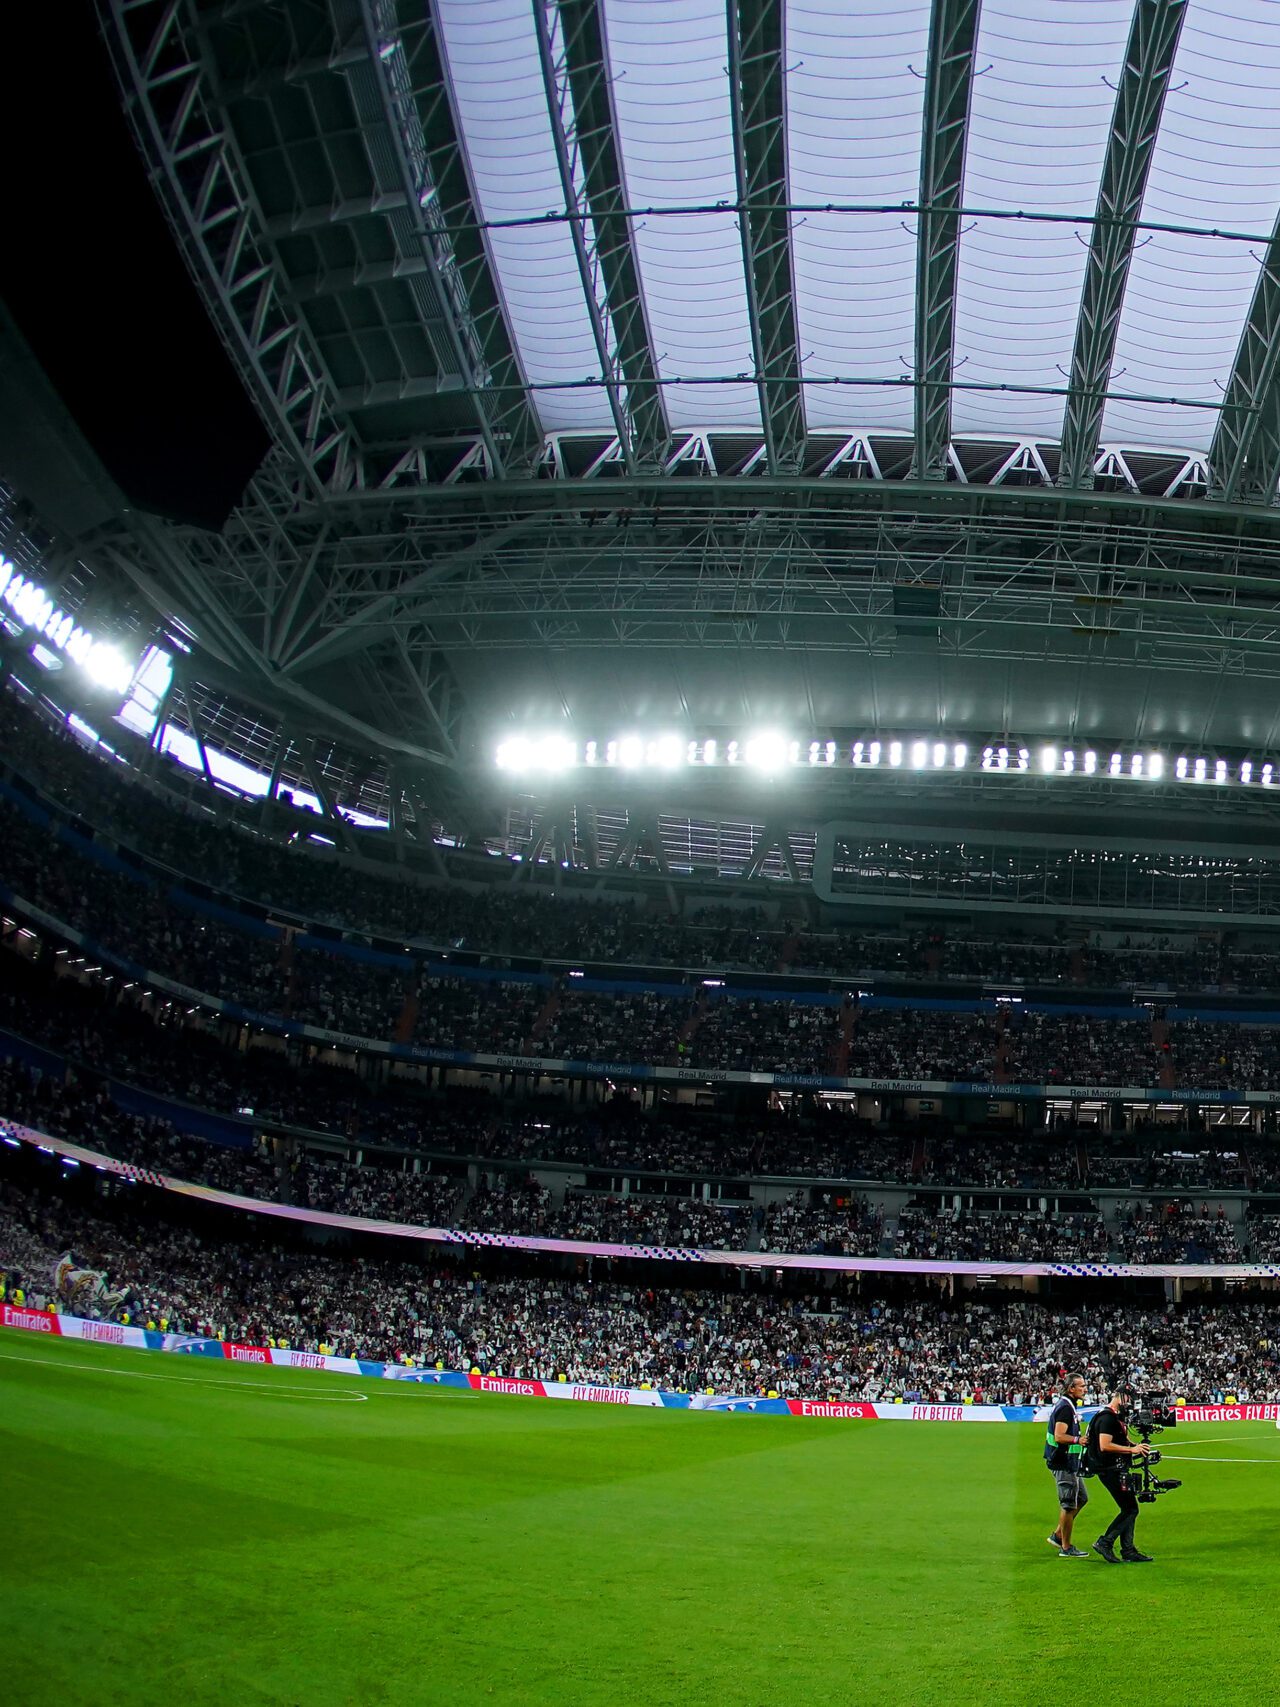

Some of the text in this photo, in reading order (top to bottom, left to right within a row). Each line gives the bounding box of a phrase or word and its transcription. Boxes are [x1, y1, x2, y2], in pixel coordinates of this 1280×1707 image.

[678, 1071, 727, 1080] Real Madrid
[775, 1075, 822, 1086] Real Madrid
[872, 1082, 922, 1091] Real Madrid
[972, 1084, 1021, 1094] Real Madrid
[1070, 1088, 1121, 1098] Real Madrid
[1172, 1090, 1221, 1100] Real Madrid
[4, 1306, 52, 1332] Emirates
[231, 1345, 266, 1363] Emirates
[290, 1352, 326, 1369] FLY BETTER
[480, 1377, 534, 1396] Emirates
[573, 1386, 630, 1404] FLY EMIRATES
[802, 1402, 863, 1418] Emirates
[912, 1406, 963, 1420] FLY BETTER
[1176, 1407, 1242, 1422] Emirates
[1246, 1406, 1262, 1420] FLY
